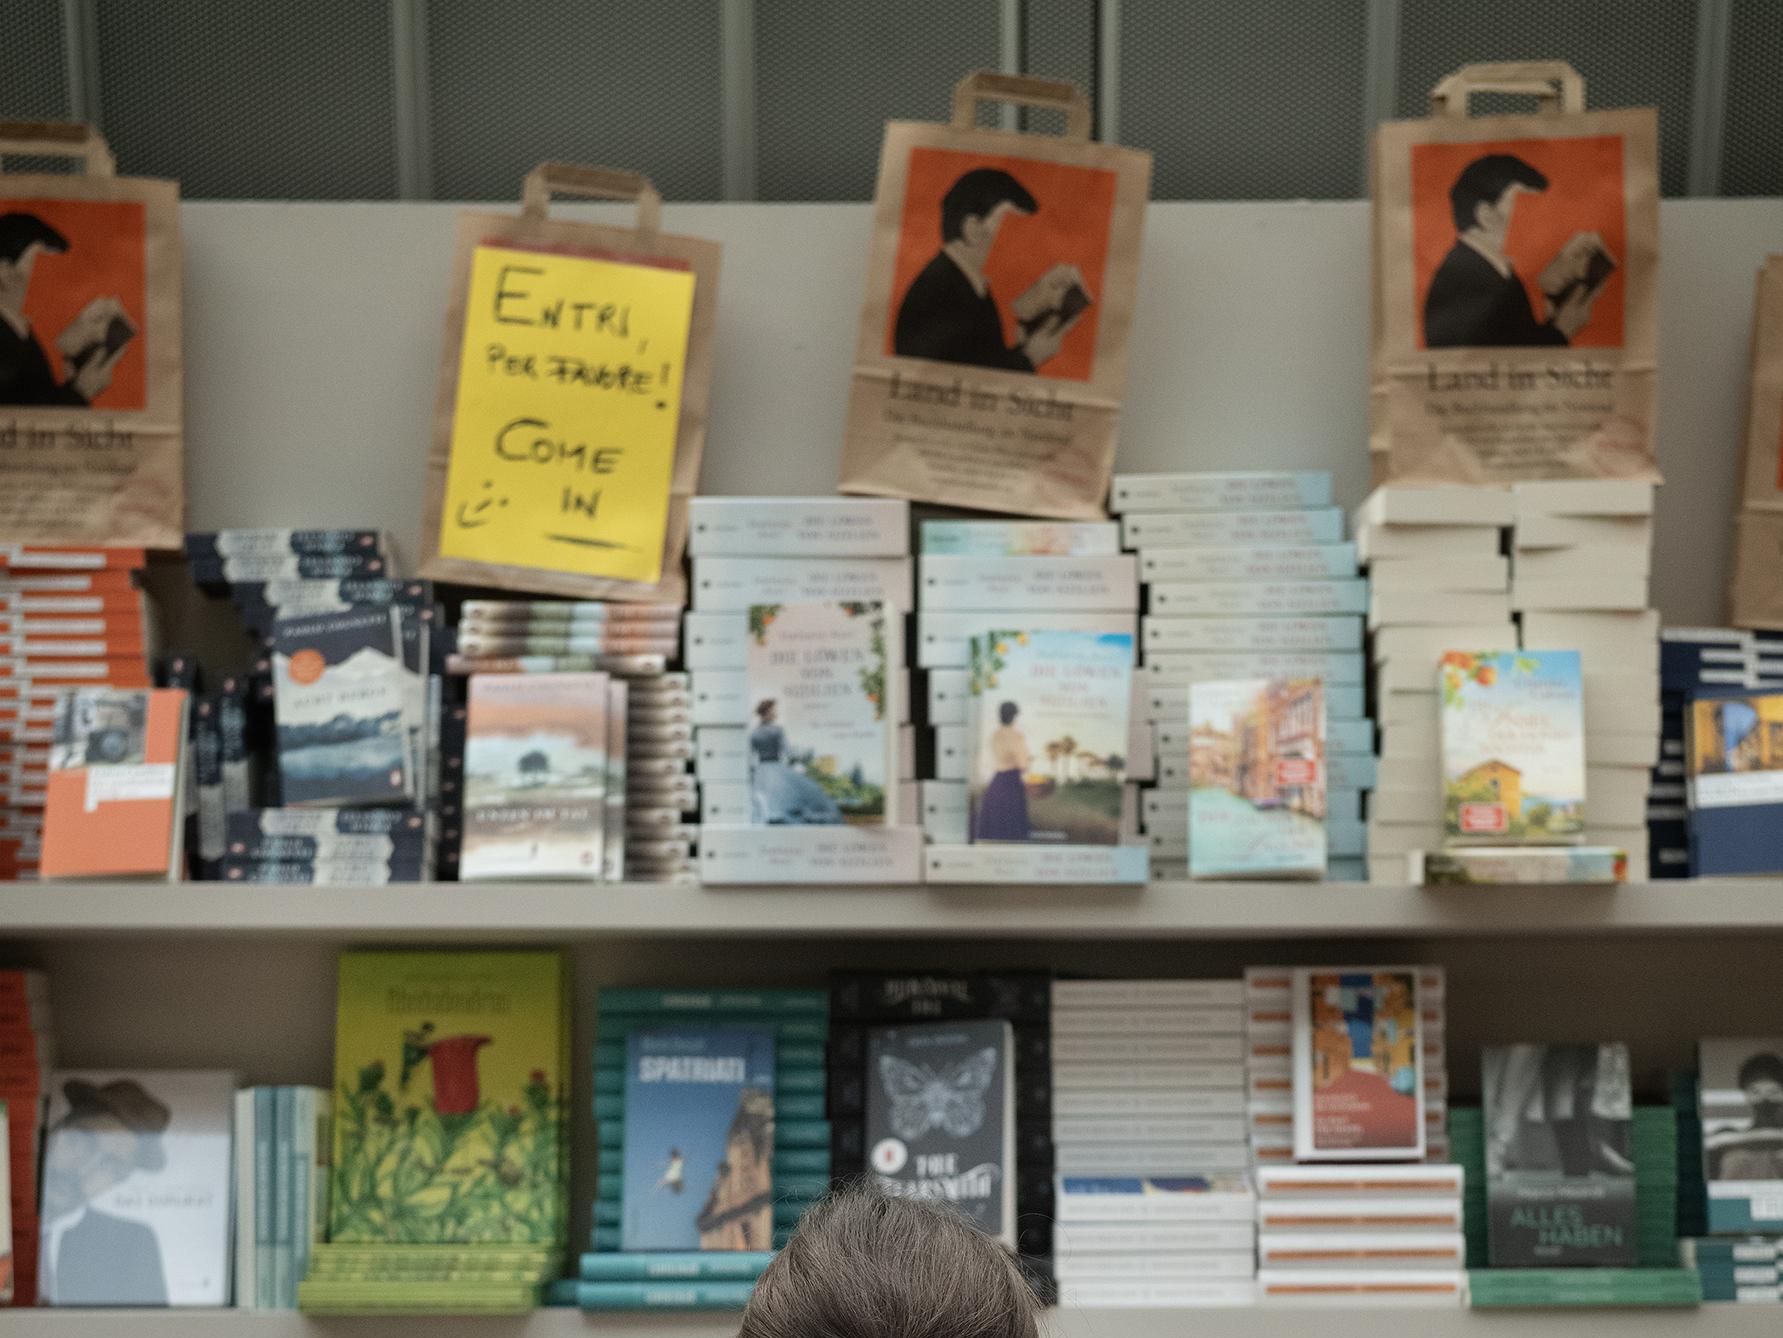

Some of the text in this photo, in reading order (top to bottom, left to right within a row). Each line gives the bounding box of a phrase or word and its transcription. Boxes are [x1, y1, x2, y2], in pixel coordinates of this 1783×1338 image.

[486, 343, 539, 379] PER
[1428, 360, 1613, 392] Land in Sicht
[890, 368, 1073, 421] Land in Sicht
[27, 424, 56, 449] in
[495, 417, 625, 474] COME
[561, 486, 603, 518] IN
[1511, 1203, 1583, 1229] ALLES
[1538, 1224, 1623, 1248] HABEN
